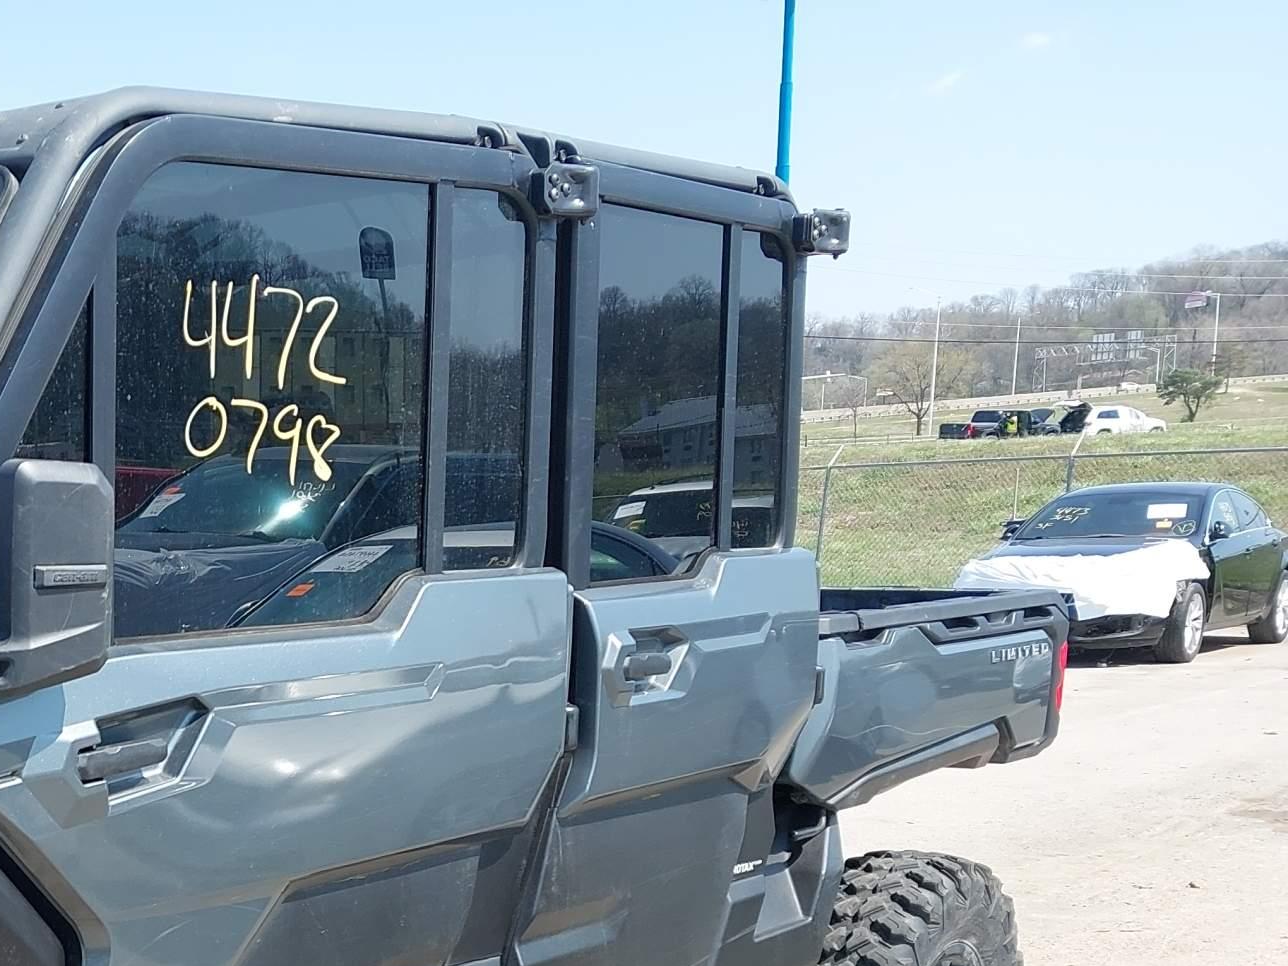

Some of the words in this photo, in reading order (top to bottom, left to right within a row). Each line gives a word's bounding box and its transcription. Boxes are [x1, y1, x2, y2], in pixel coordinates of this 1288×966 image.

[183, 273, 347, 390] 4472
[184, 396, 341, 487] 0798
[991, 642, 1049, 664] LIMITED
